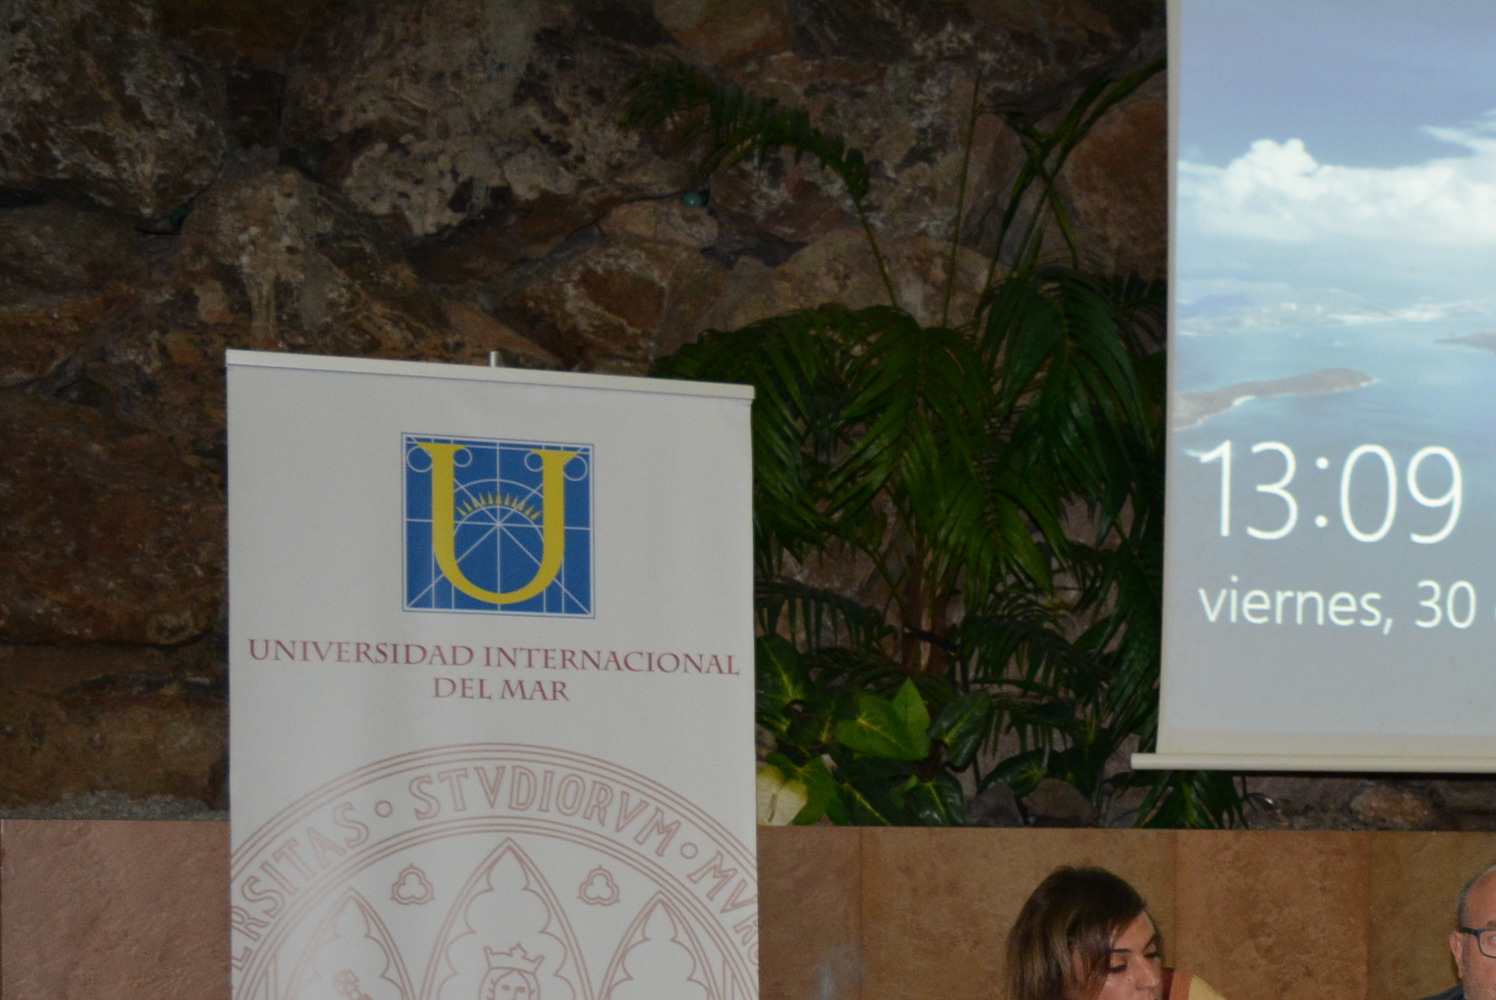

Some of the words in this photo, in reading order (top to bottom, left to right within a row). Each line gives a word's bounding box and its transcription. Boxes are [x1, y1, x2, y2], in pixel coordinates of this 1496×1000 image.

[1198, 440, 1463, 545] 13:09
[1199, 575, 1394, 636] viernes,
[1415, 580, 1478, 629] 30
[248, 638, 474, 666] UNIVERSIDAD
[483, 646, 741, 677] INTERNACIONAL
[432, 677, 492, 701] DEL
[499, 680, 571, 702] MAR
